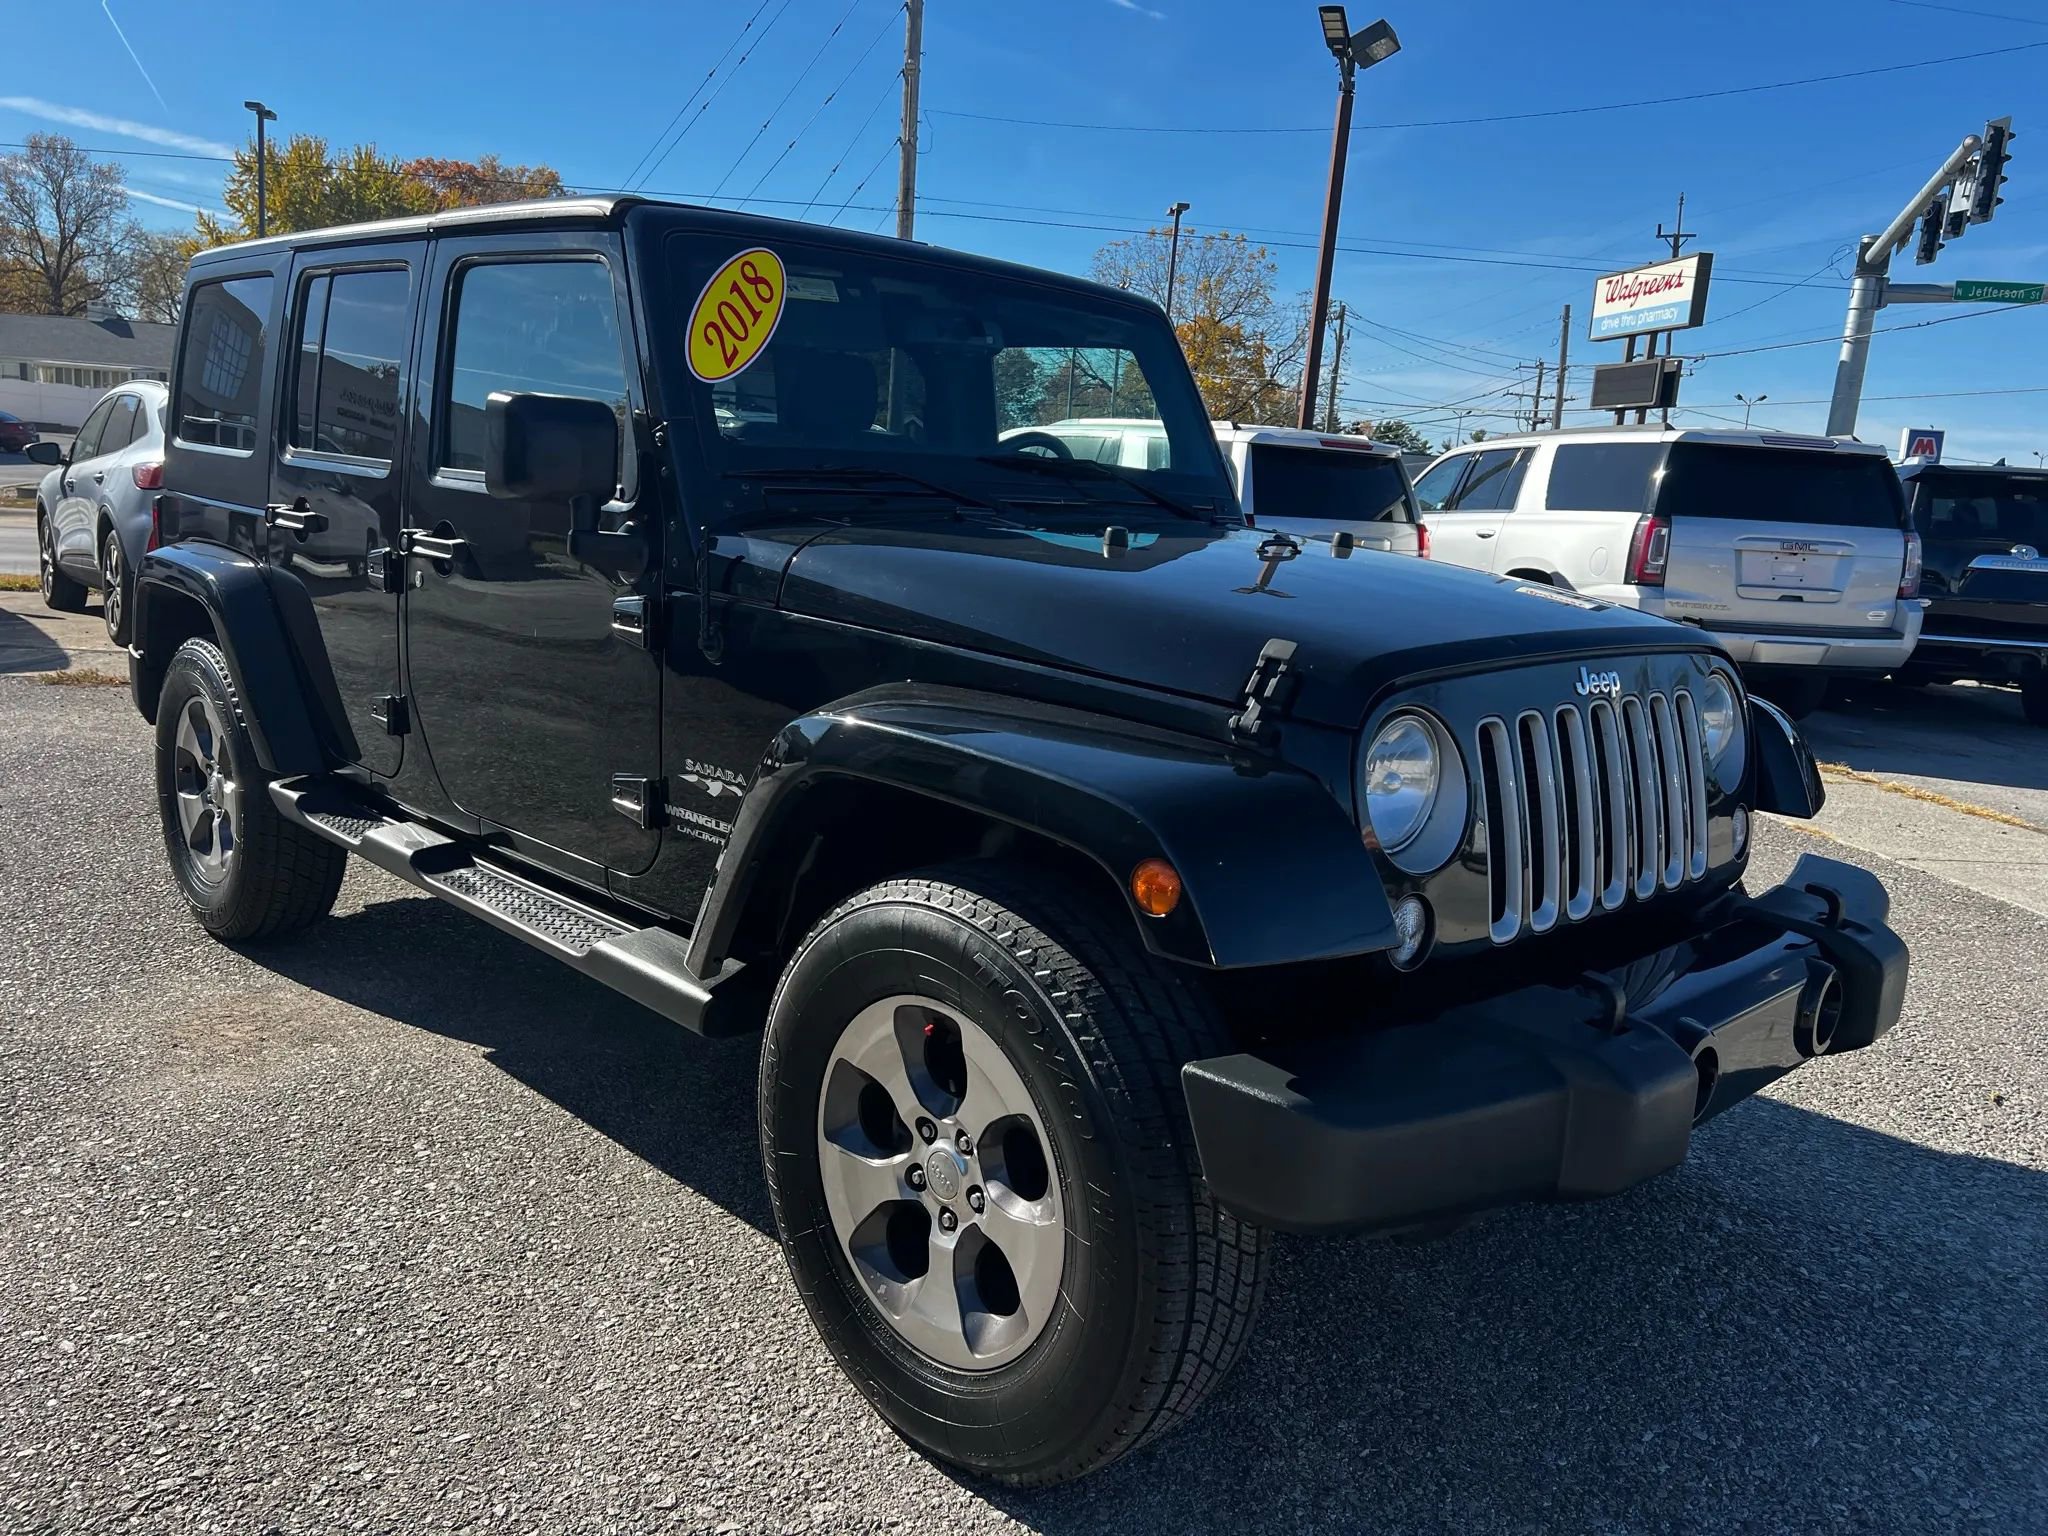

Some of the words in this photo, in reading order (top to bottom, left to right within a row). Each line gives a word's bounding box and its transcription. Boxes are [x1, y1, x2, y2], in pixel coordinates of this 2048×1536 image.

[1605, 268, 1684, 308] Walgreens
[1956, 287, 1963, 297] N
[1968, 285, 2025, 299] Jefferson
[2029, 290, 2040, 300] St
[703, 260, 774, 369] 2018
[1600, 316, 1620, 331] drive
[1621, 312, 1637, 328] thru
[1637, 306, 1679, 327] pharmacy
[1780, 541, 1819, 552] GMC
[1575, 666, 1621, 698] Jeep
[685, 758, 747, 786] SAHARA
